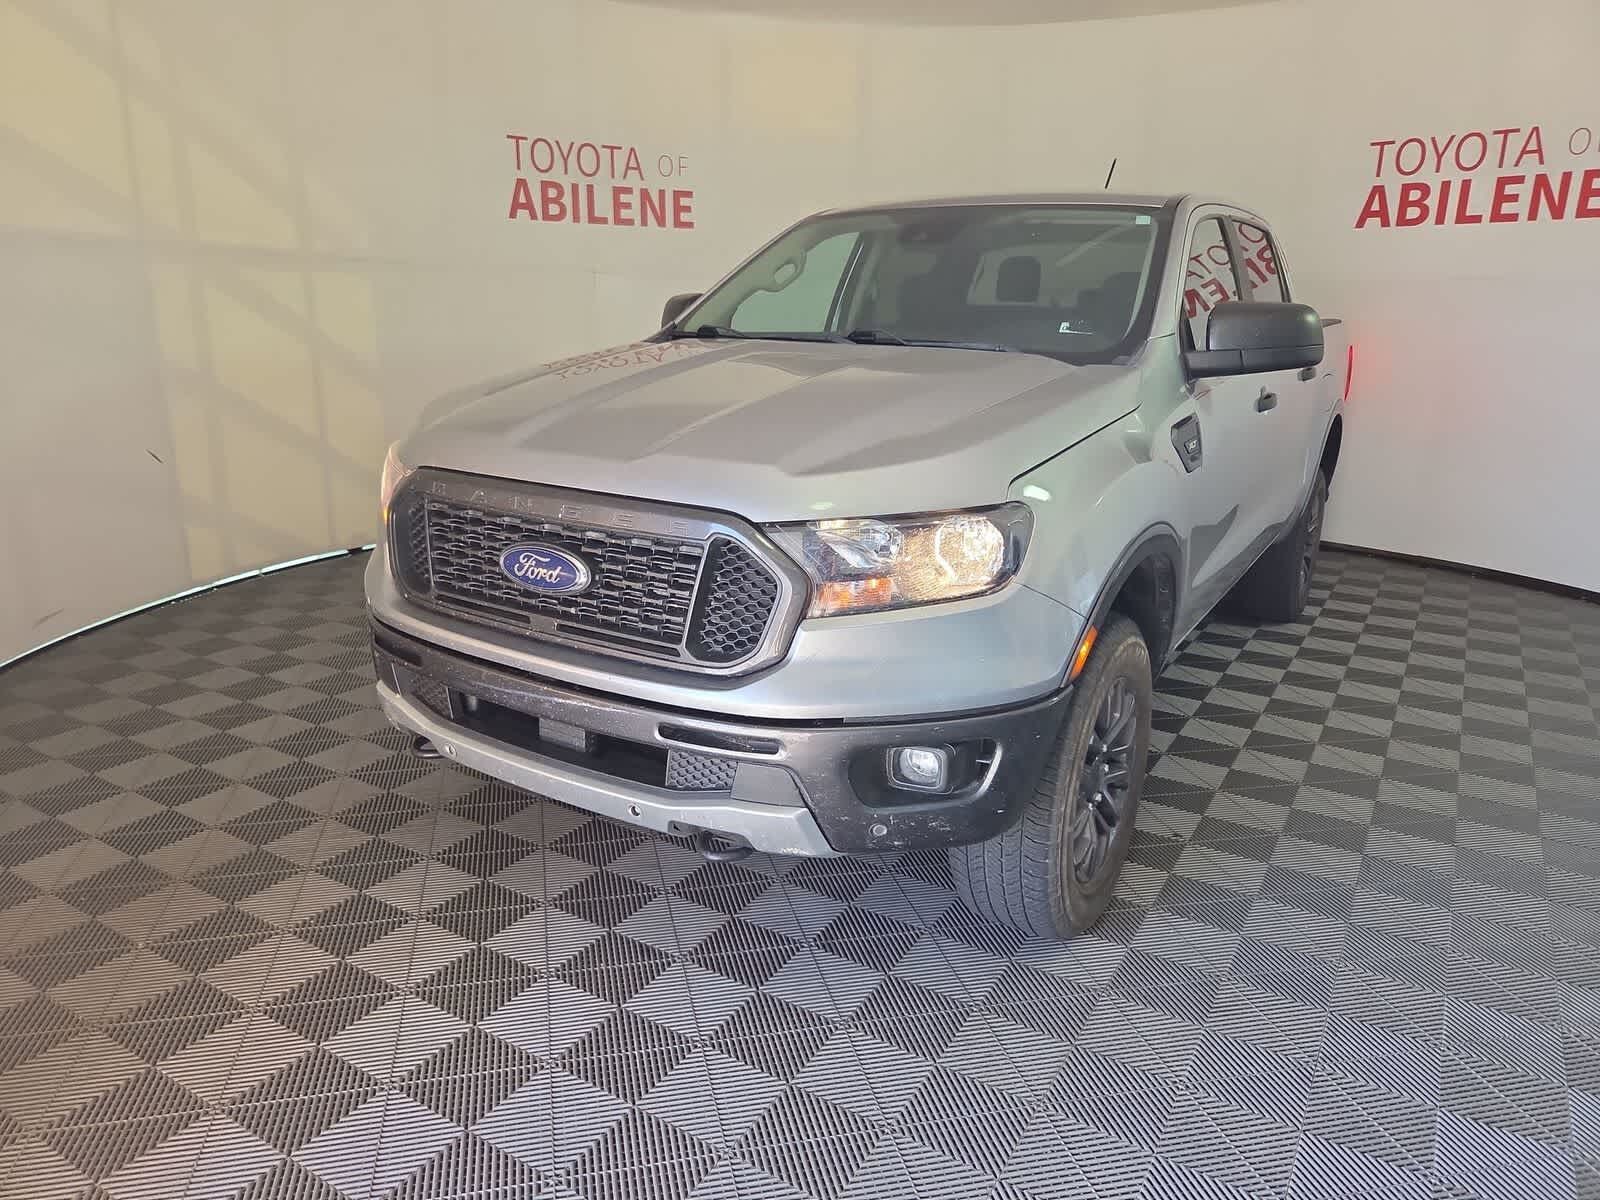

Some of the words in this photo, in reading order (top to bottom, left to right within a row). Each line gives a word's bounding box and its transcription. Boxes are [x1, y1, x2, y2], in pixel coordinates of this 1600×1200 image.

[506, 134, 644, 181] TOYOTA
[658, 154, 689, 177] OF
[1369, 126, 1545, 178] TOYOTA
[1568, 127, 1600, 156] O
[507, 178, 695, 229] ABILENE
[1354, 168, 1600, 229] ABILENE
[514, 552, 567, 585] Ford
